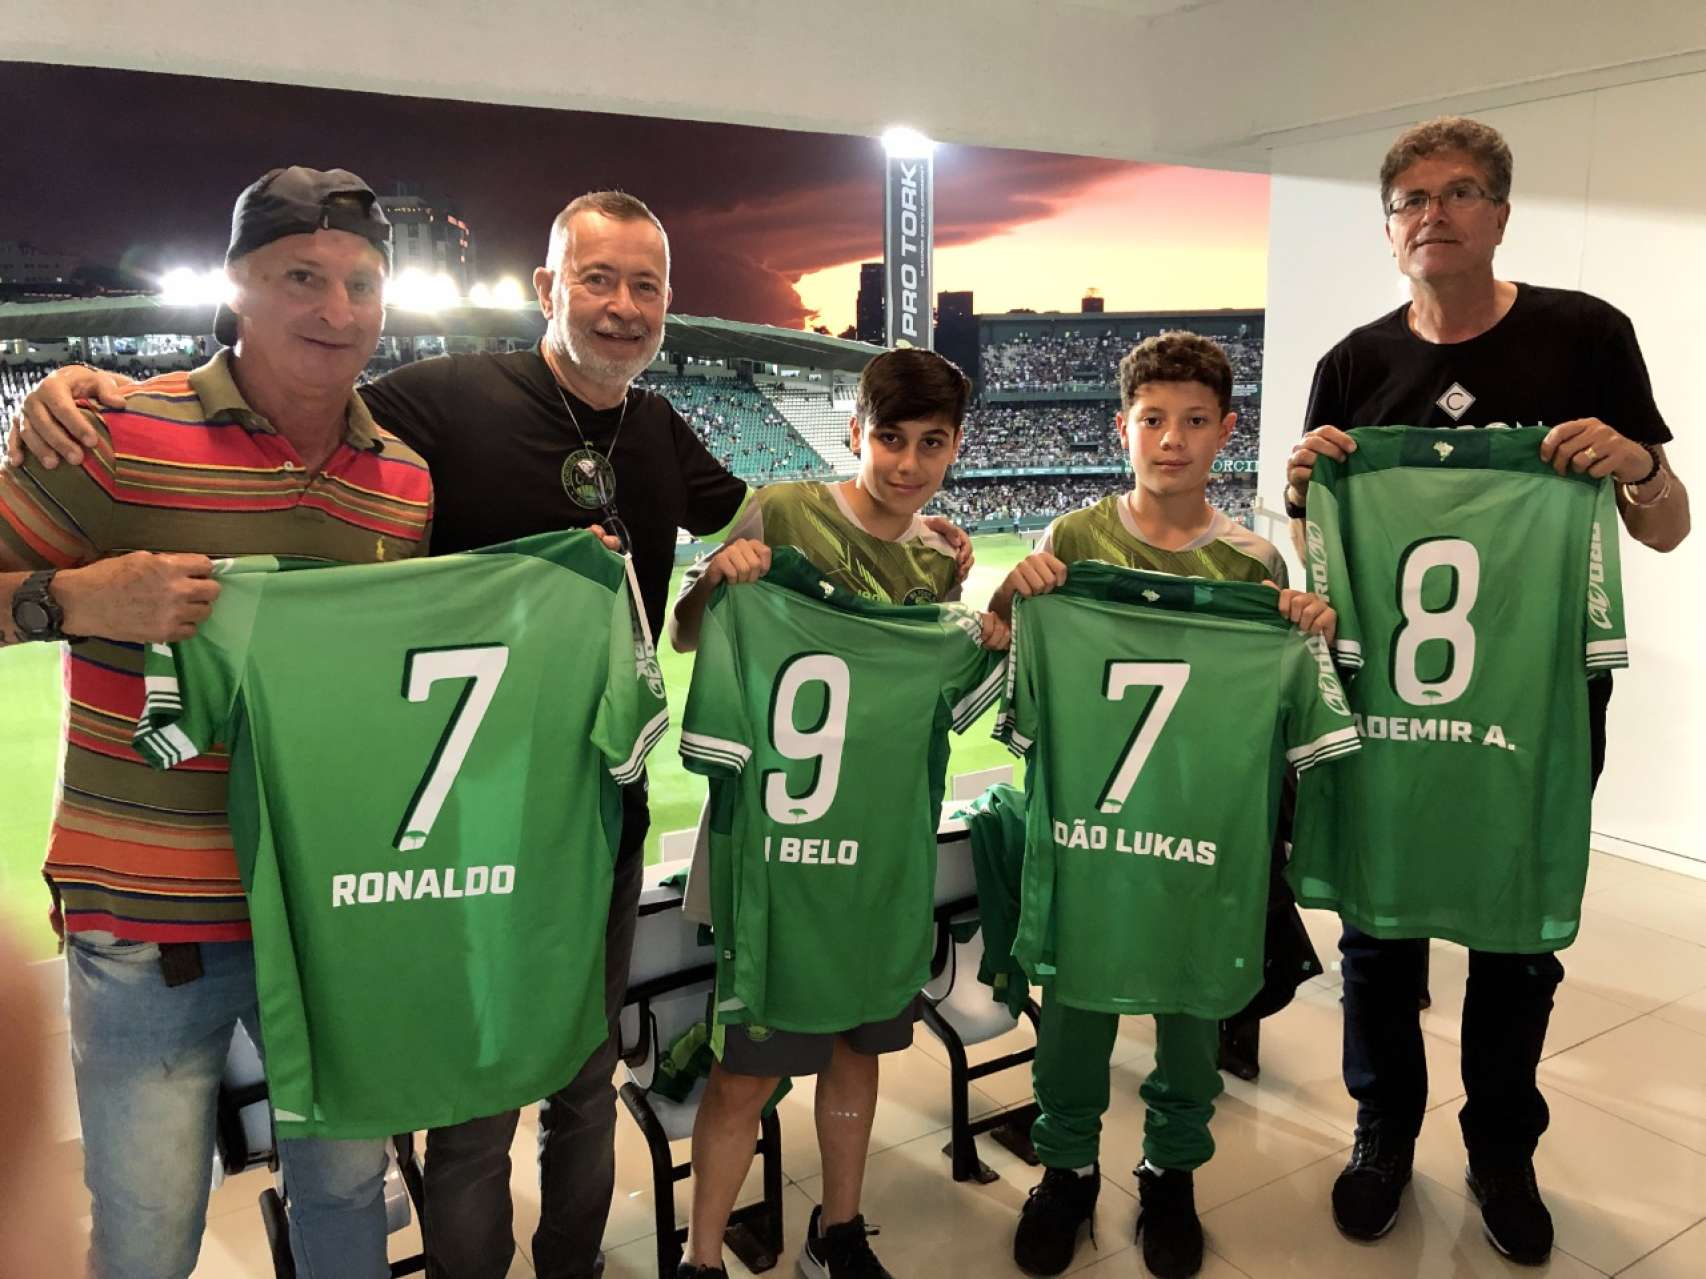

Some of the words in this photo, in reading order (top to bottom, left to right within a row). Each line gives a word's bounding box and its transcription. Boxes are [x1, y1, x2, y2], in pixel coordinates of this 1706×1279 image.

[900, 160, 919, 257] TORK
[900, 263, 919, 338] PRO
[1390, 536, 1481, 706] 8
[396, 643, 510, 852] 7
[763, 652, 851, 825] 9
[1097, 660, 1192, 814] 7
[332, 864, 516, 908] RONALDO
[779, 836, 859, 866] BELO
[1115, 827, 1217, 866] LUKAS
